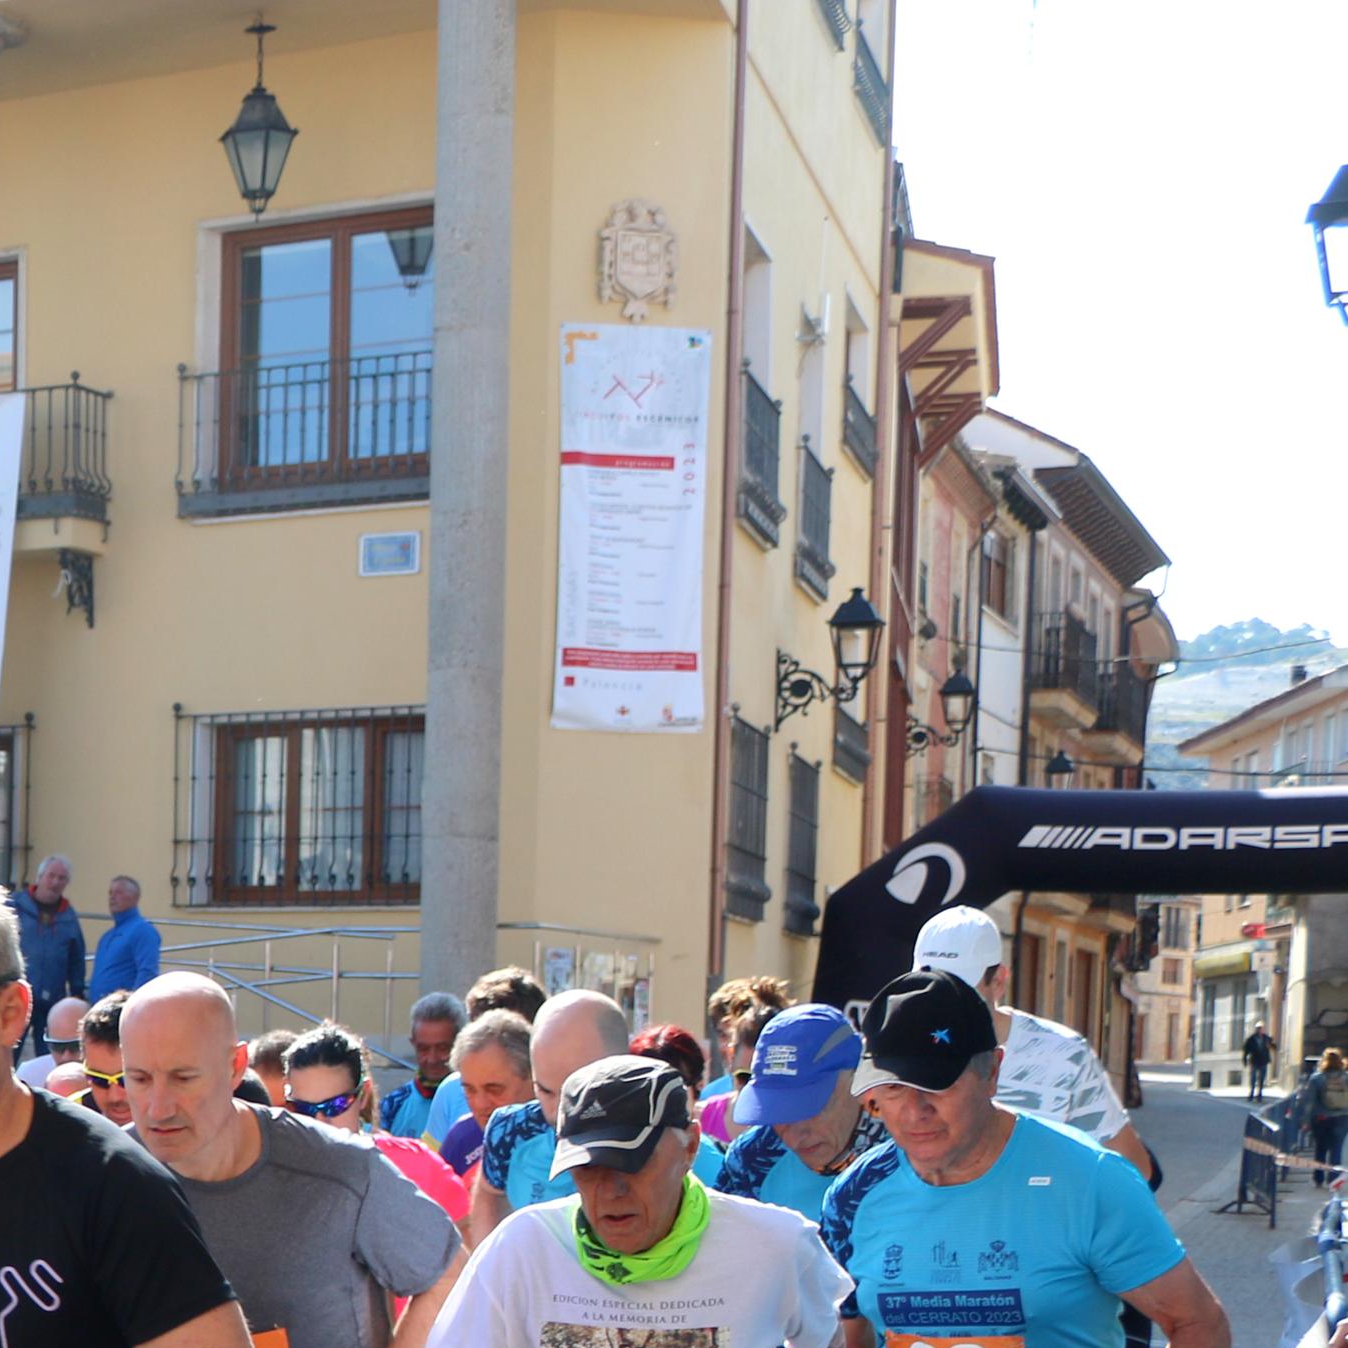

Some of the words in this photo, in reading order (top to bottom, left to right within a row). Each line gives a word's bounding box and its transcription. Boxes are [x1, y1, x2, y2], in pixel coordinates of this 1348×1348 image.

[552, 1294, 598, 1308] EDICION
[602, 1298, 657, 1311] ESPECIAL
[659, 1296, 726, 1311] DEDICADA
[910, 1295, 951, 1309] Media
[955, 1293, 1015, 1308] Maratón
[582, 1311, 589, 1320] A
[592, 1312, 604, 1322] LA
[609, 1313, 667, 1325] MEMORIA
[671, 1314, 688, 1324] DE
[885, 1312, 905, 1325] del
[908, 1311, 982, 1325] CERRATO
[986, 1310, 1023, 1324] 2023
